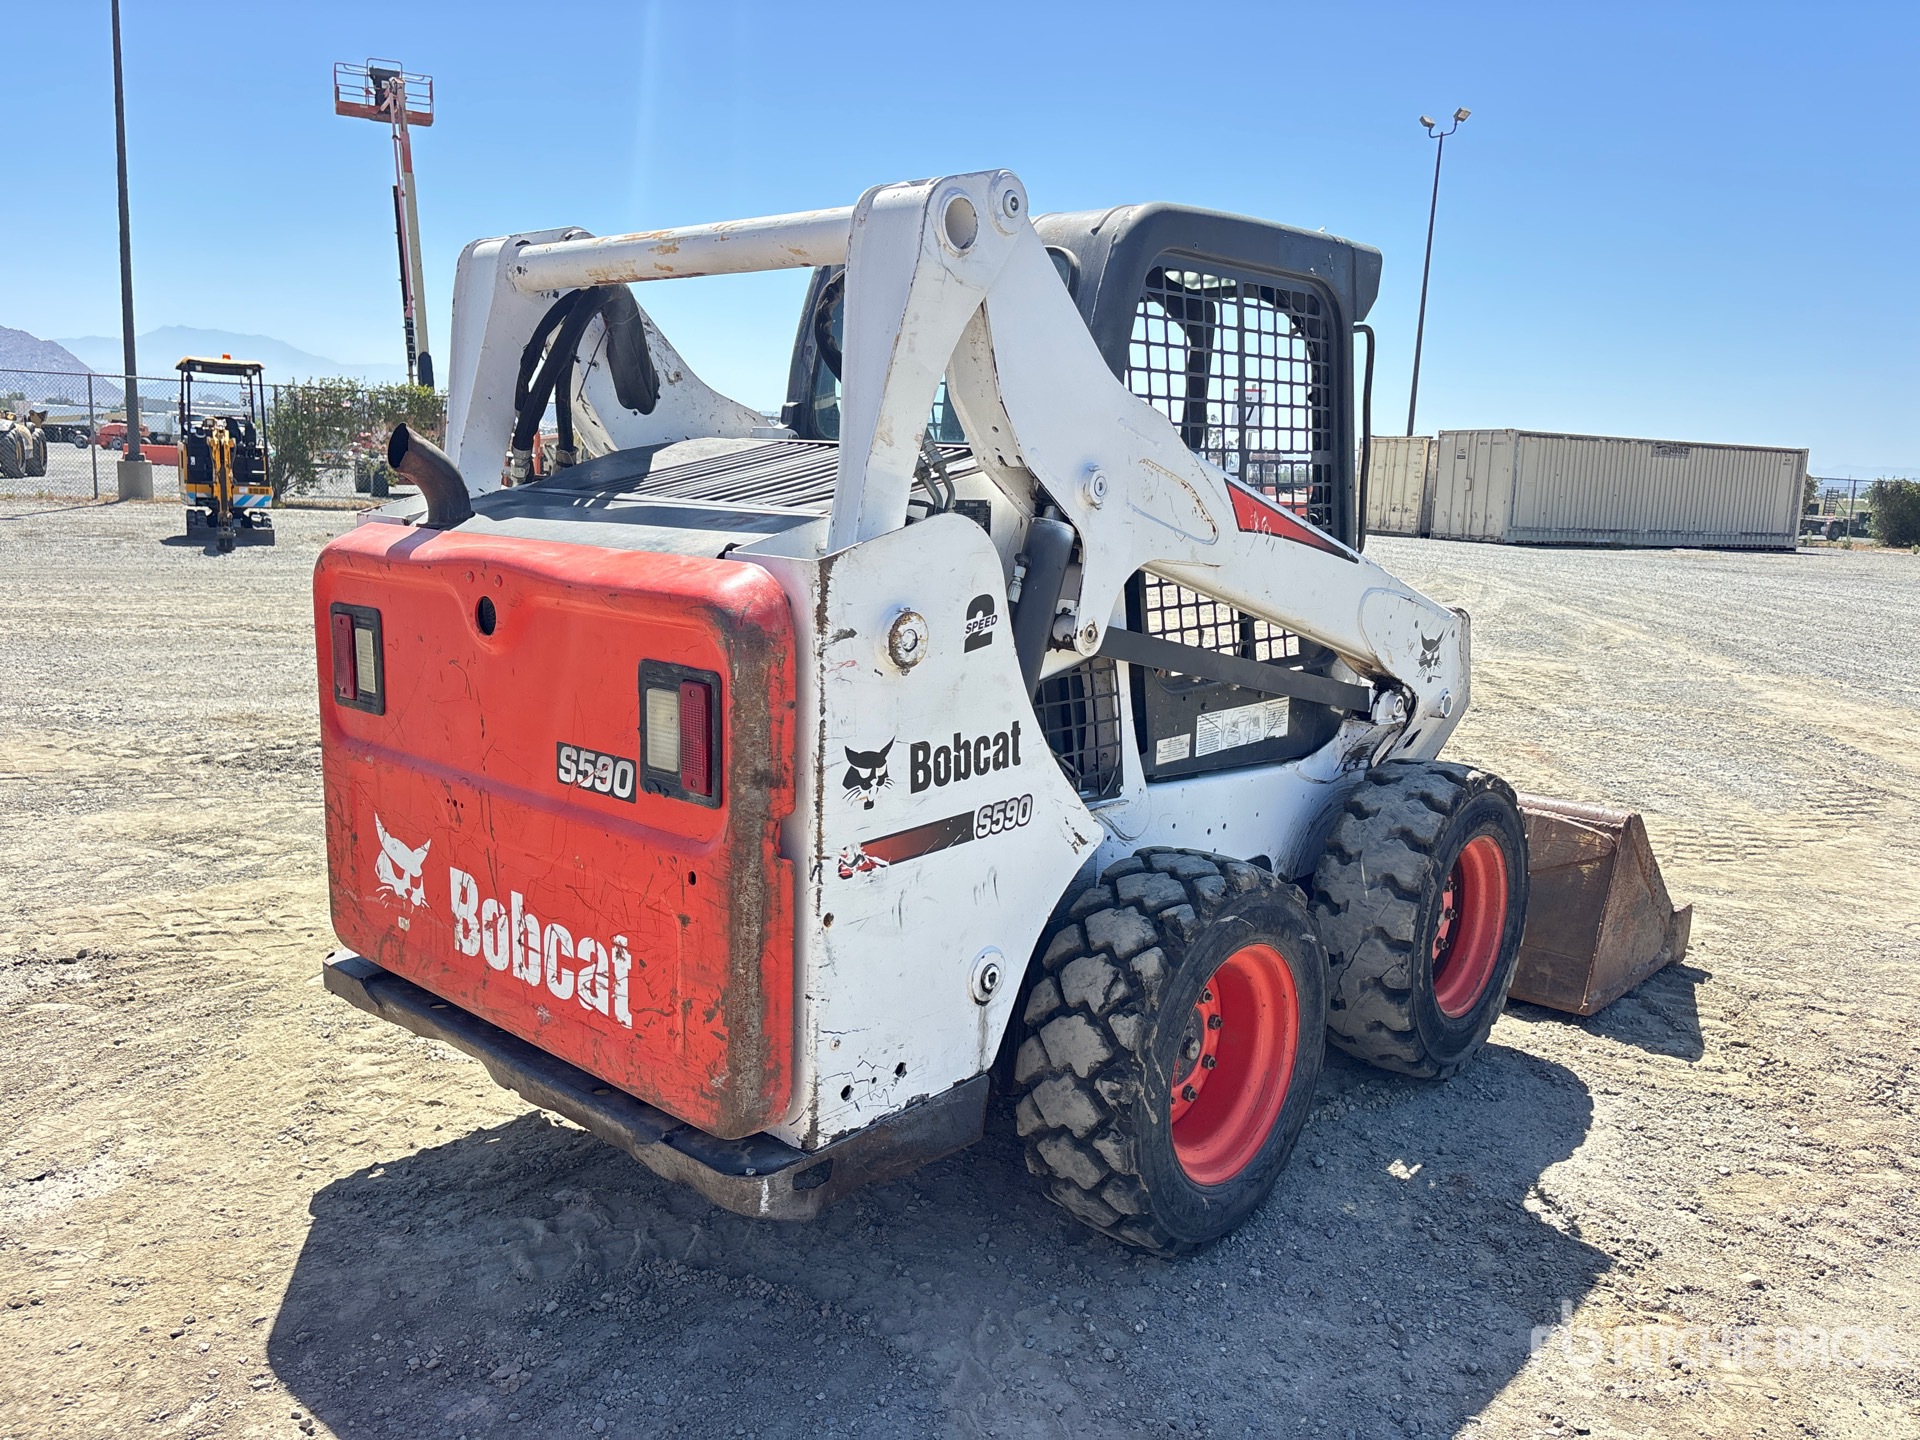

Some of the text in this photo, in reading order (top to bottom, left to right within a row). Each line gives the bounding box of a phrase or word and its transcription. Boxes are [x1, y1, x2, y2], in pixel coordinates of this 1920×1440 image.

[964, 594, 995, 653] 2
[965, 614, 998, 635] SPEED
[558, 746, 634, 799] S590
[910, 720, 1021, 794] Bobcat
[976, 793, 1033, 839] S590
[450, 866, 633, 1030] Bobcat
